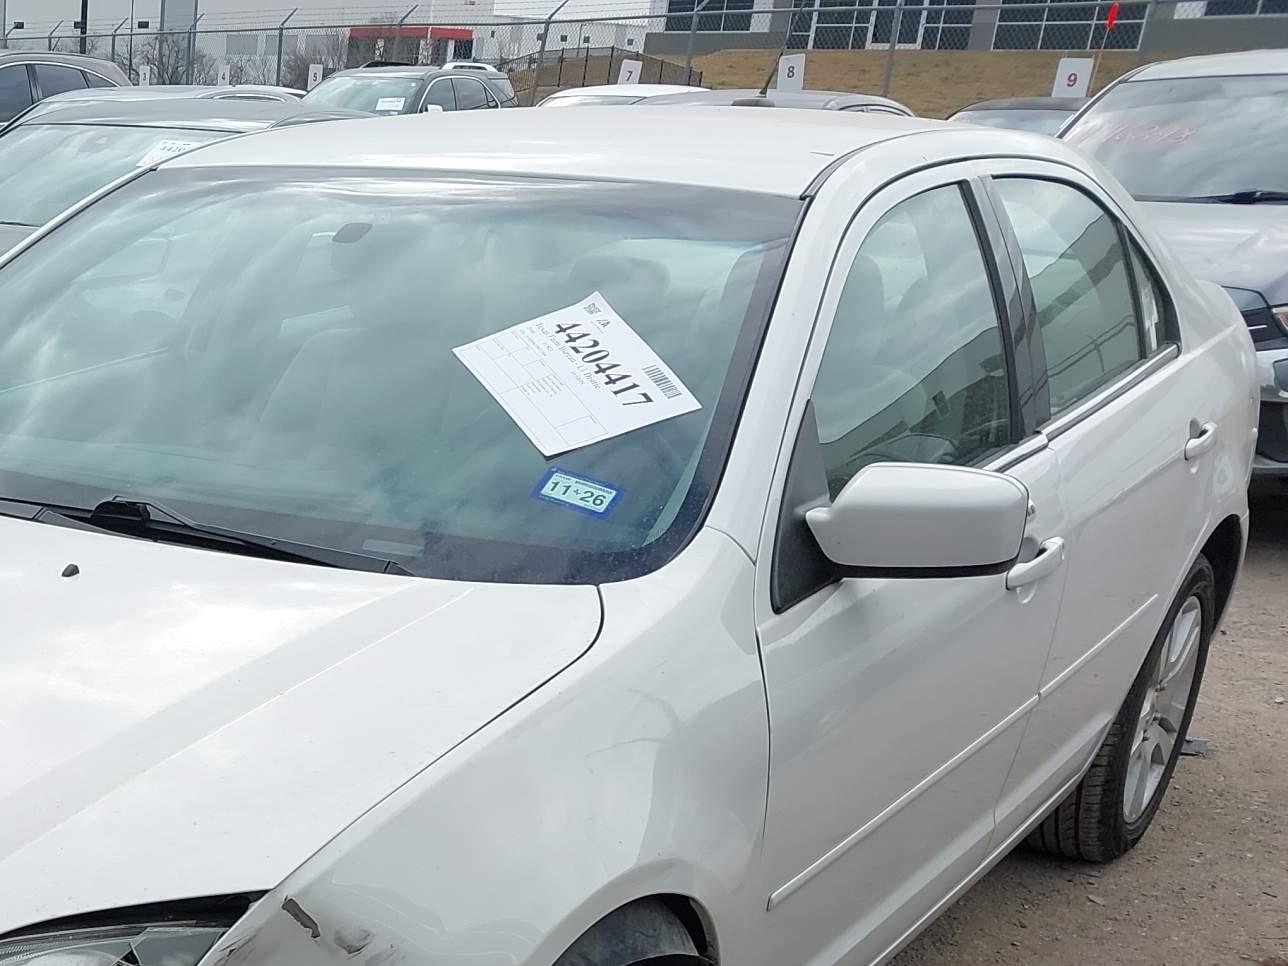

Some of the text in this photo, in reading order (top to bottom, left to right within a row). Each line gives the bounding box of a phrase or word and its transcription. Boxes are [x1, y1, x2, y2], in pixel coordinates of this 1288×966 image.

[312, 72, 318, 82] 5
[625, 70, 632, 81] 7
[786, 65, 795, 78] 8
[1066, 72, 1078, 87] 9
[555, 322, 654, 407] 44204417
